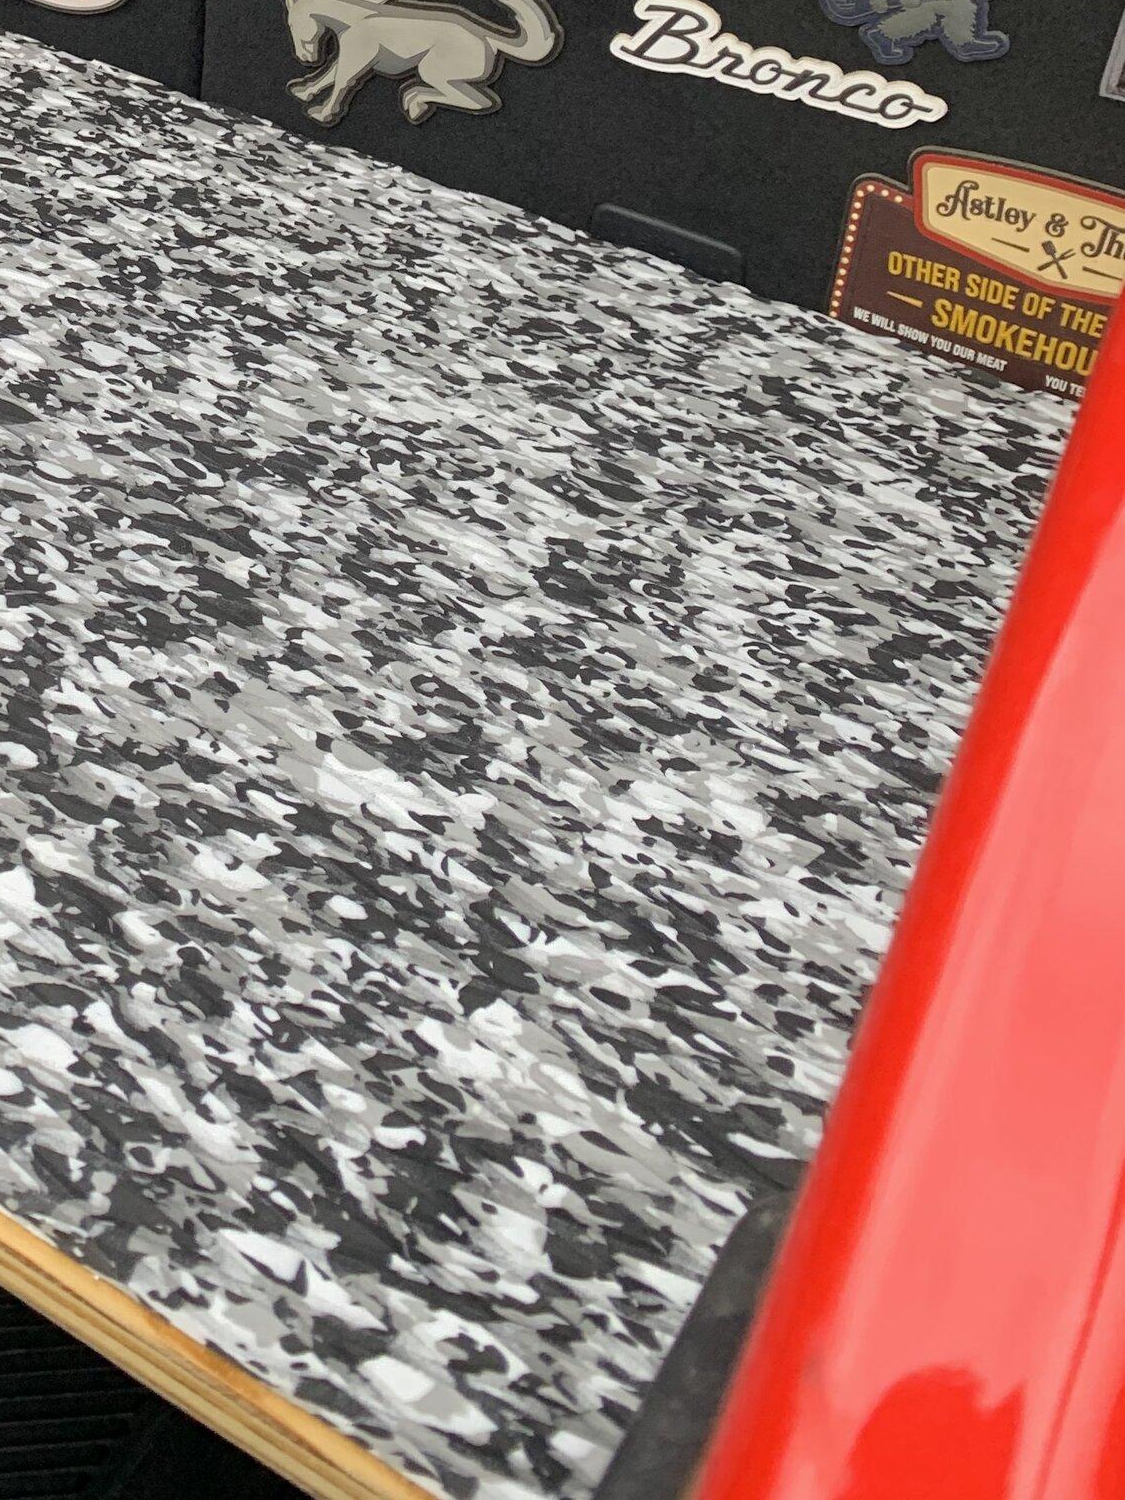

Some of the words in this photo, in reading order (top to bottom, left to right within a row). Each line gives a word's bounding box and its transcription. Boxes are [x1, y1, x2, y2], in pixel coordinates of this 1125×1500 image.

[619, 3, 934, 121] Bronco
[935, 179, 1037, 233] Astley
[1044, 212, 1069, 238] &
[1080, 215, 1125, 260] Th
[887, 250, 961, 293] OTHER
[966, 273, 1020, 311] SIDE
[1021, 291, 1053, 321] OF
[1060, 302, 1108, 339] THE
[853, 306, 871, 324] WE
[871, 310, 896, 333] WILL
[897, 323, 930, 345] SHOW
[930, 334, 952, 353] YOU
[953, 343, 976, 361] OUR
[975, 351, 1008, 372] MEAT
[1044, 374, 1069, 393] YOU
